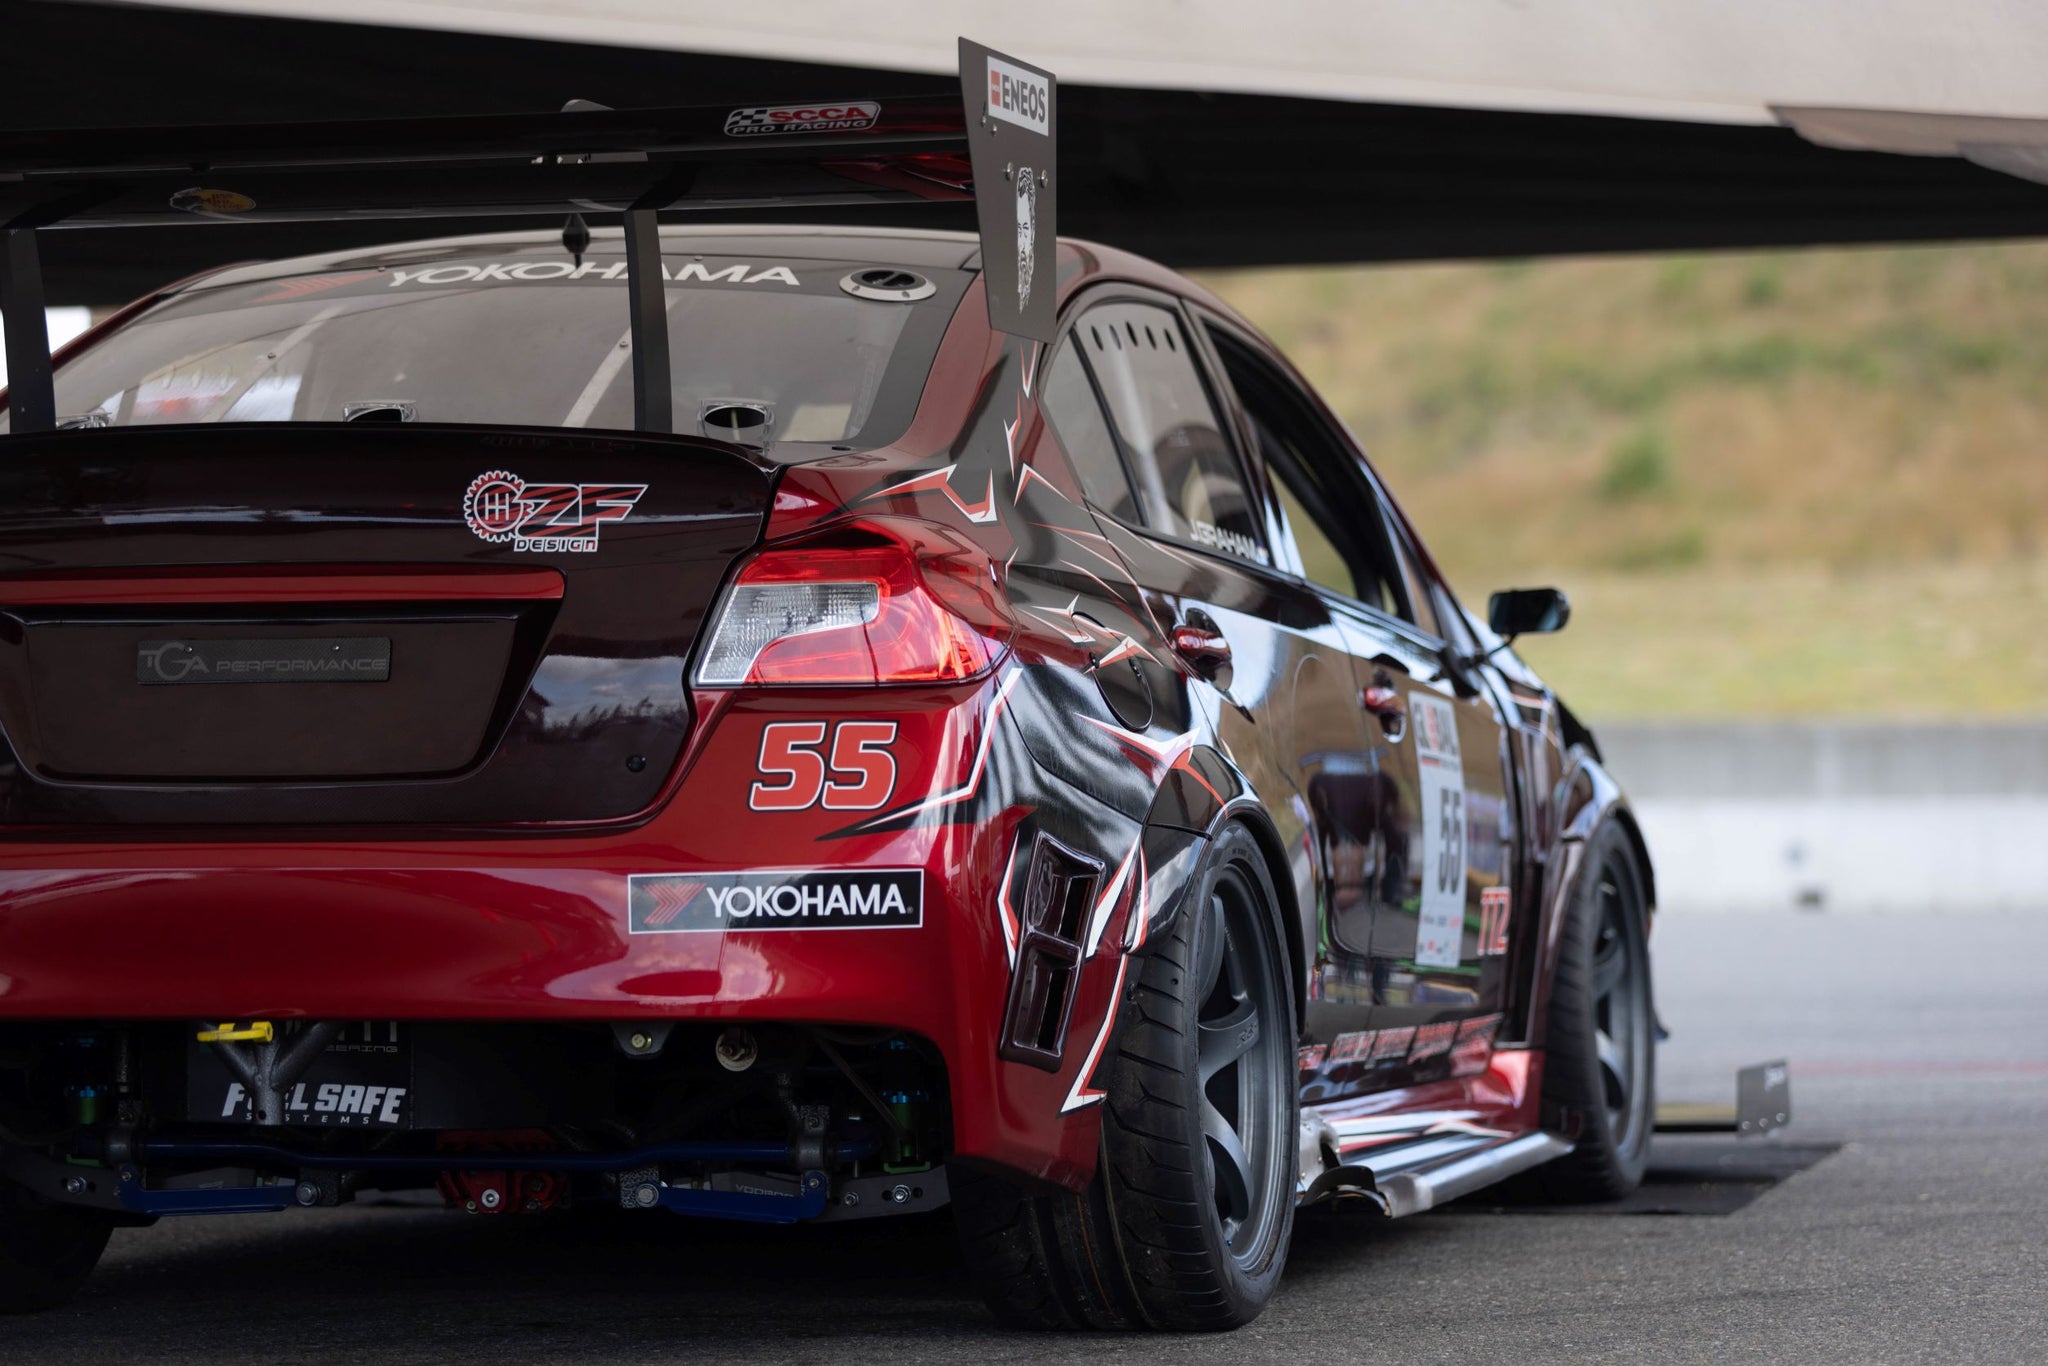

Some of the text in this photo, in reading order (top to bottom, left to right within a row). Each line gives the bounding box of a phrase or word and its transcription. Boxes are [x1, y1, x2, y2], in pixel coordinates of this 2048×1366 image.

[1002, 74, 1046, 124] ENEOS
[732, 120, 868, 134] PRO RACING
[768, 107, 870, 122] SCCA
[514, 538, 599, 552] DESIGN
[215, 656, 388, 672] PERFORMANCE
[748, 720, 899, 811] 55
[1439, 788, 1463, 894] 55
[706, 883, 907, 918] YOKOHAMA
[221, 1082, 407, 1123] FL SAFE
[244, 1111, 371, 1124] SSTEMS
